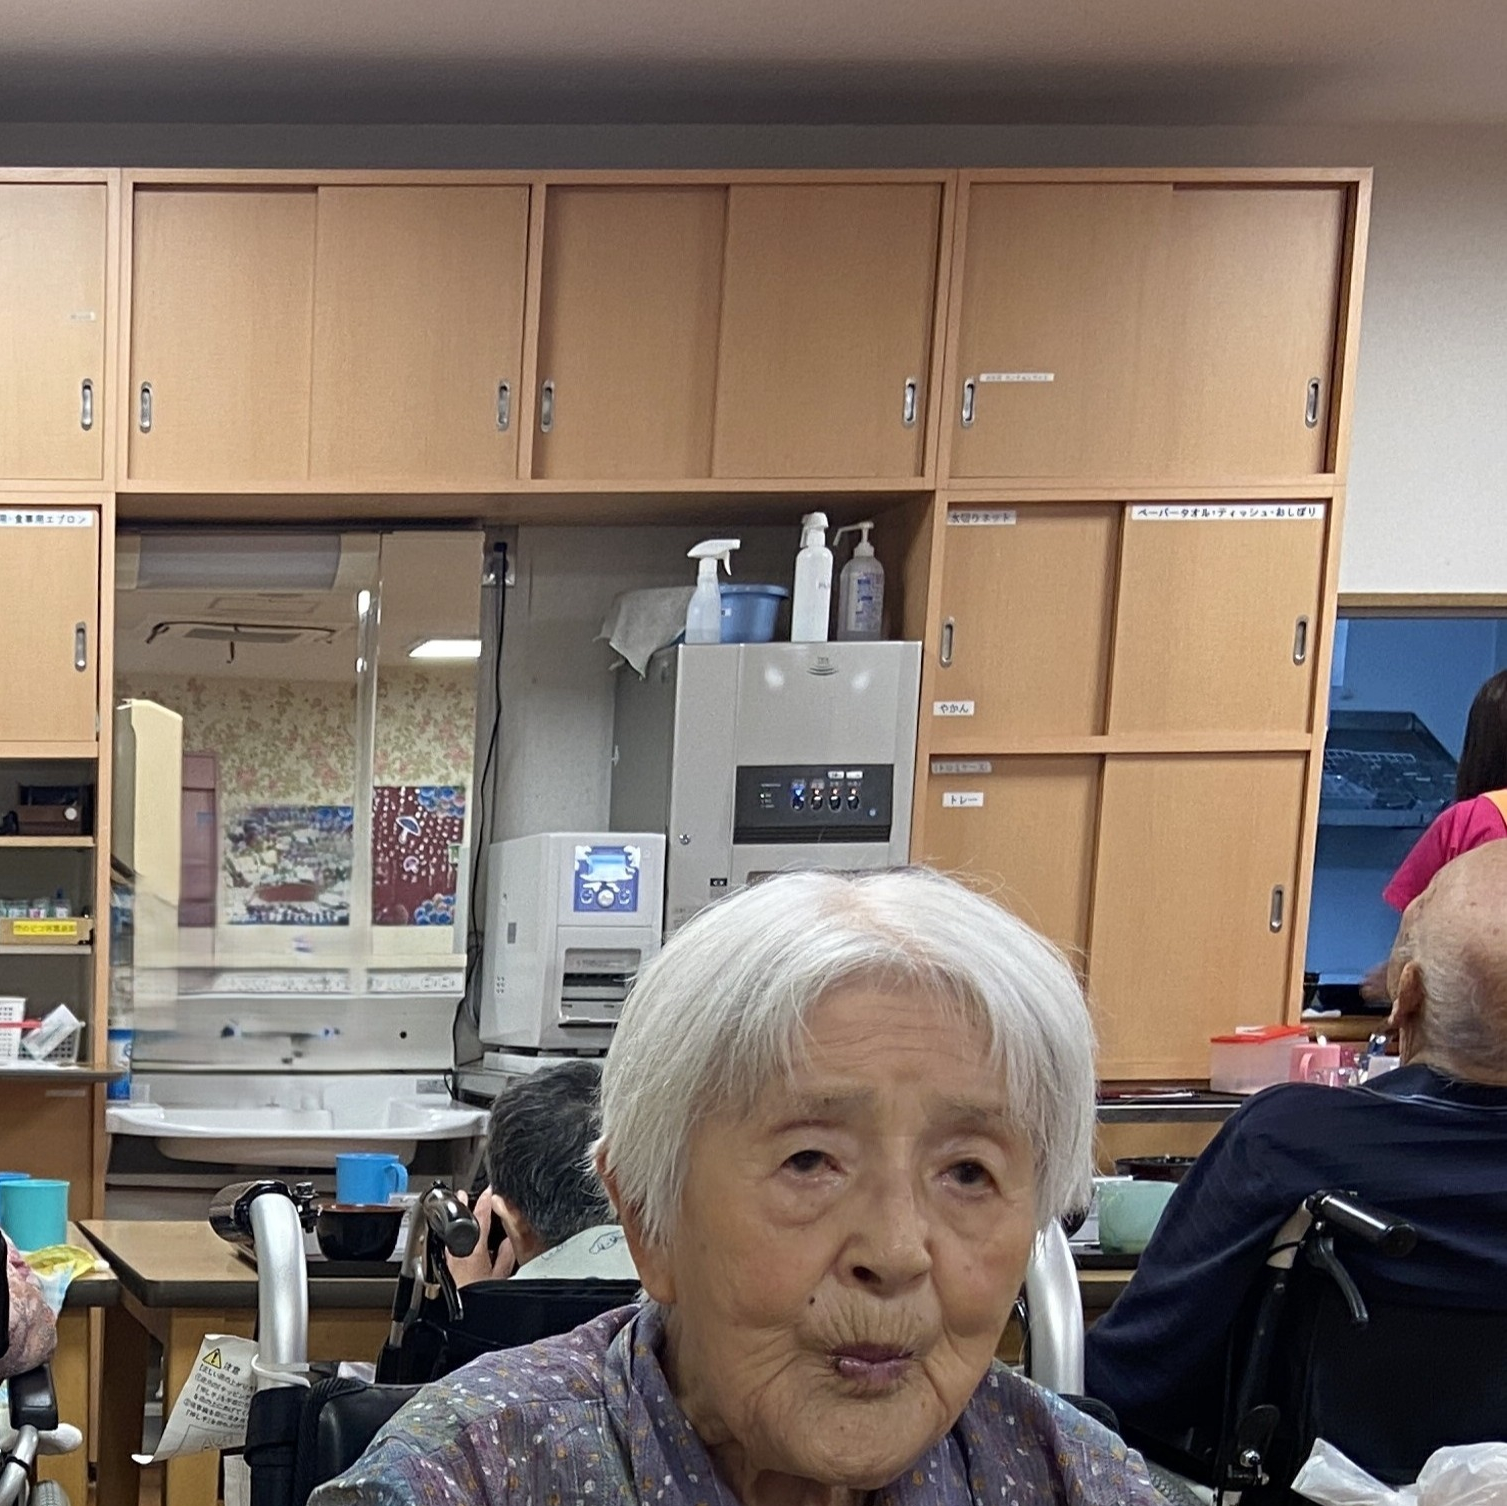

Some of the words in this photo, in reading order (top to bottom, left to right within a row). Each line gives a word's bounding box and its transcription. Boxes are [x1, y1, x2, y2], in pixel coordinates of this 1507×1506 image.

[938, 703, 969, 714] やかん
[951, 794, 978, 805] トレー
[223, 1361, 241, 1376] 注意
